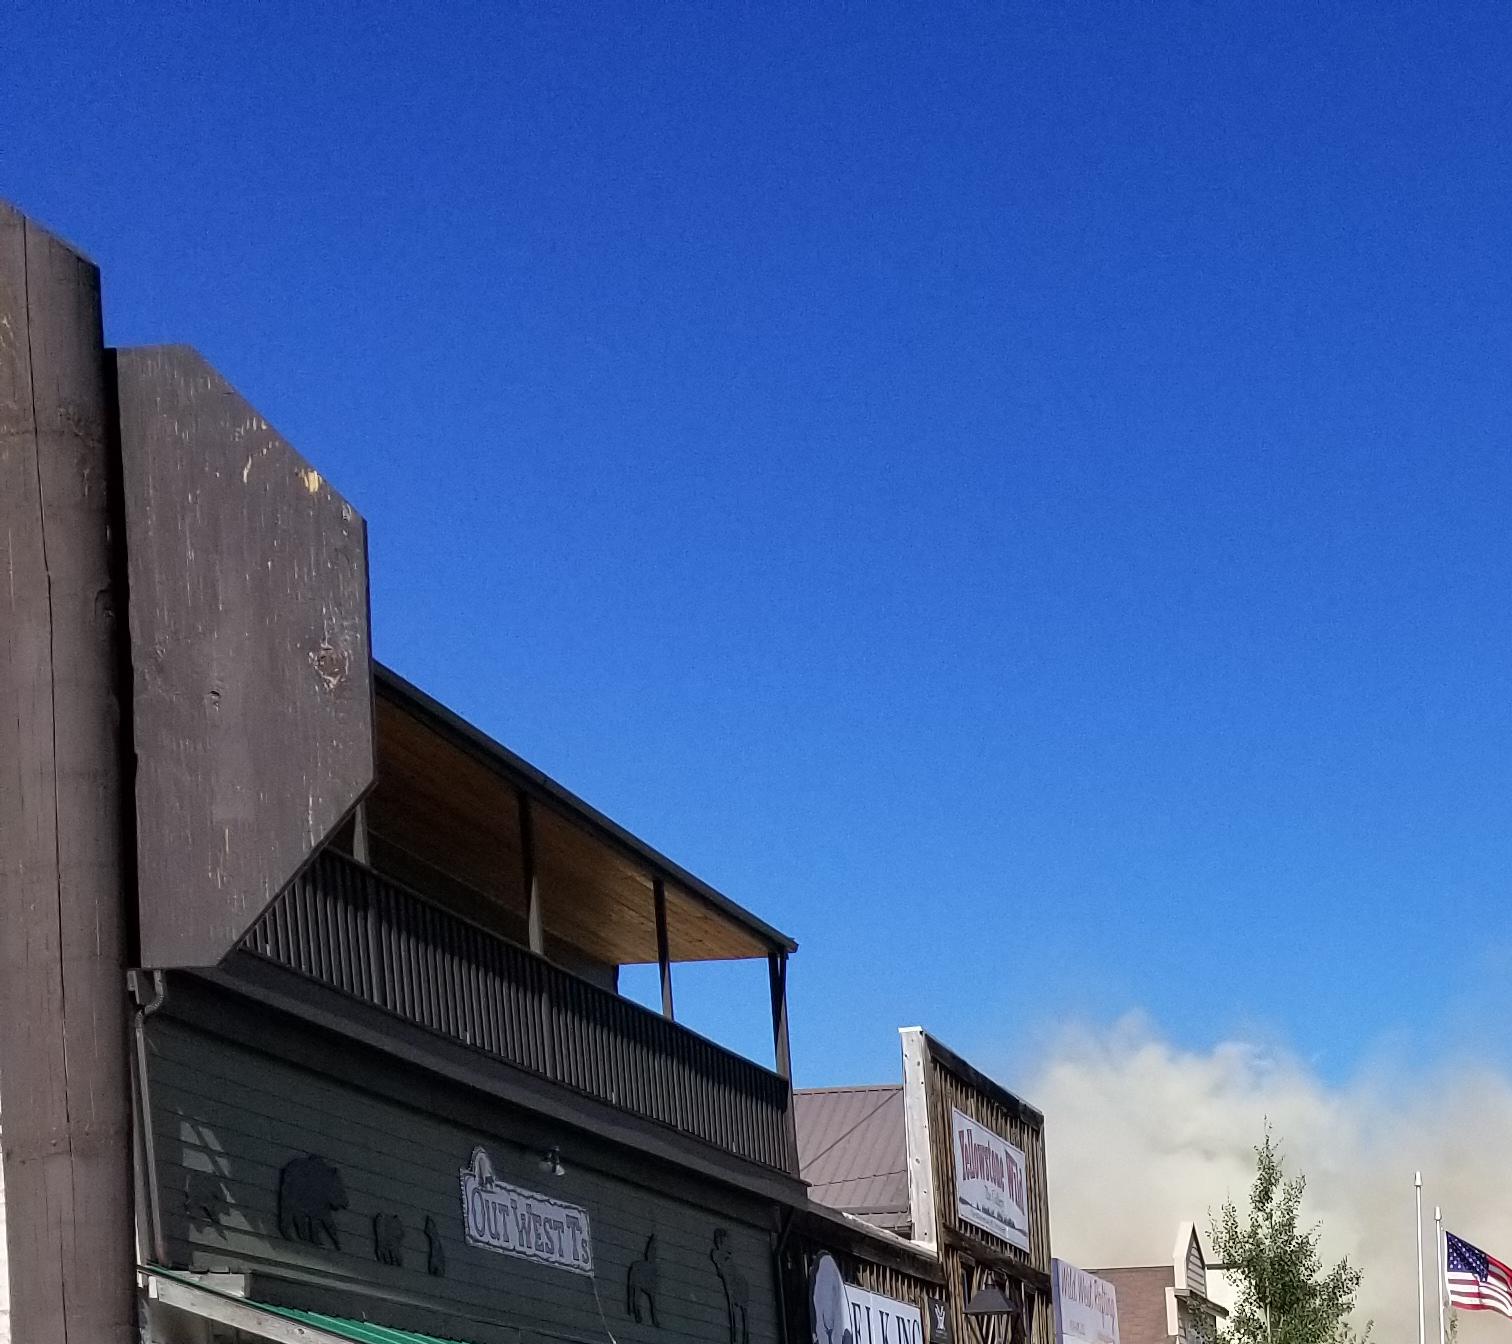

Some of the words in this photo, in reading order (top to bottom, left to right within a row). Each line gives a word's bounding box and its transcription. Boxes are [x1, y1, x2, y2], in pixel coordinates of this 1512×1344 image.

[959, 1129, 1005, 1193] Yellowstone
[472, 1187, 509, 1242] OUT
[510, 1198, 564, 1257] WEST
